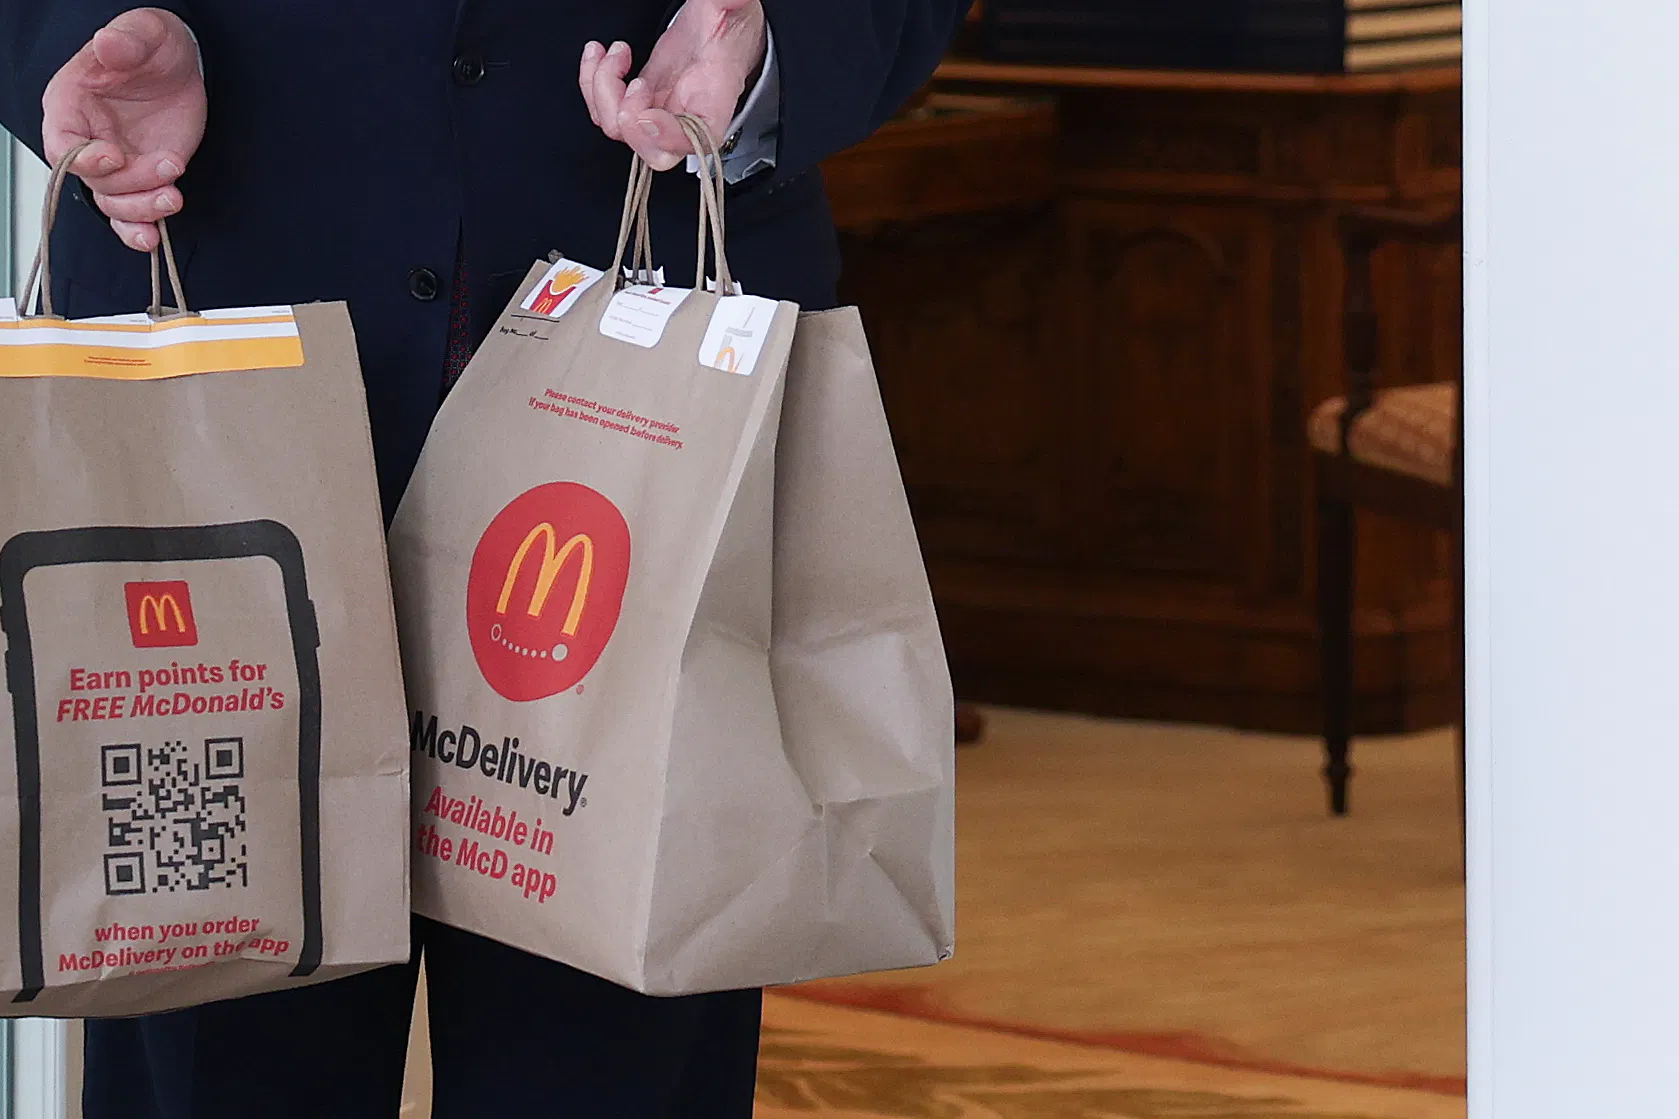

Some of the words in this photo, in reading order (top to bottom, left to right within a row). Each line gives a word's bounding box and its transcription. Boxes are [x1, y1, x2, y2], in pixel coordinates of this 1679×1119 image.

[533, 400, 551, 410] your
[550, 402, 566, 417] bag
[565, 407, 579, 419] has
[579, 410, 599, 425] been
[599, 418, 630, 434] opened
[629, 425, 657, 442] before
[544, 388, 568, 401] Please
[567, 396, 597, 410] contact
[595, 404, 617, 416] your
[616, 409, 649, 427] delivery
[649, 420, 680, 434] provider
[69, 667, 132, 692] Earn
[137, 662, 225, 693] points
[228, 659, 268, 683] for
[56, 696, 126, 723] FREE
[129, 686, 285, 718] McDonald’s
[424, 785, 529, 847] Available
[530, 817, 555, 856] in
[418, 823, 453, 861] the
[455, 837, 510, 880] McD
[511, 862, 558, 904] app
[94, 923, 154, 942] when
[158, 920, 197, 943] you
[202, 916, 260, 935] order
[58, 947, 176, 972] McDelivery
[181, 943, 208, 959] on
[248, 936, 290, 956] app
